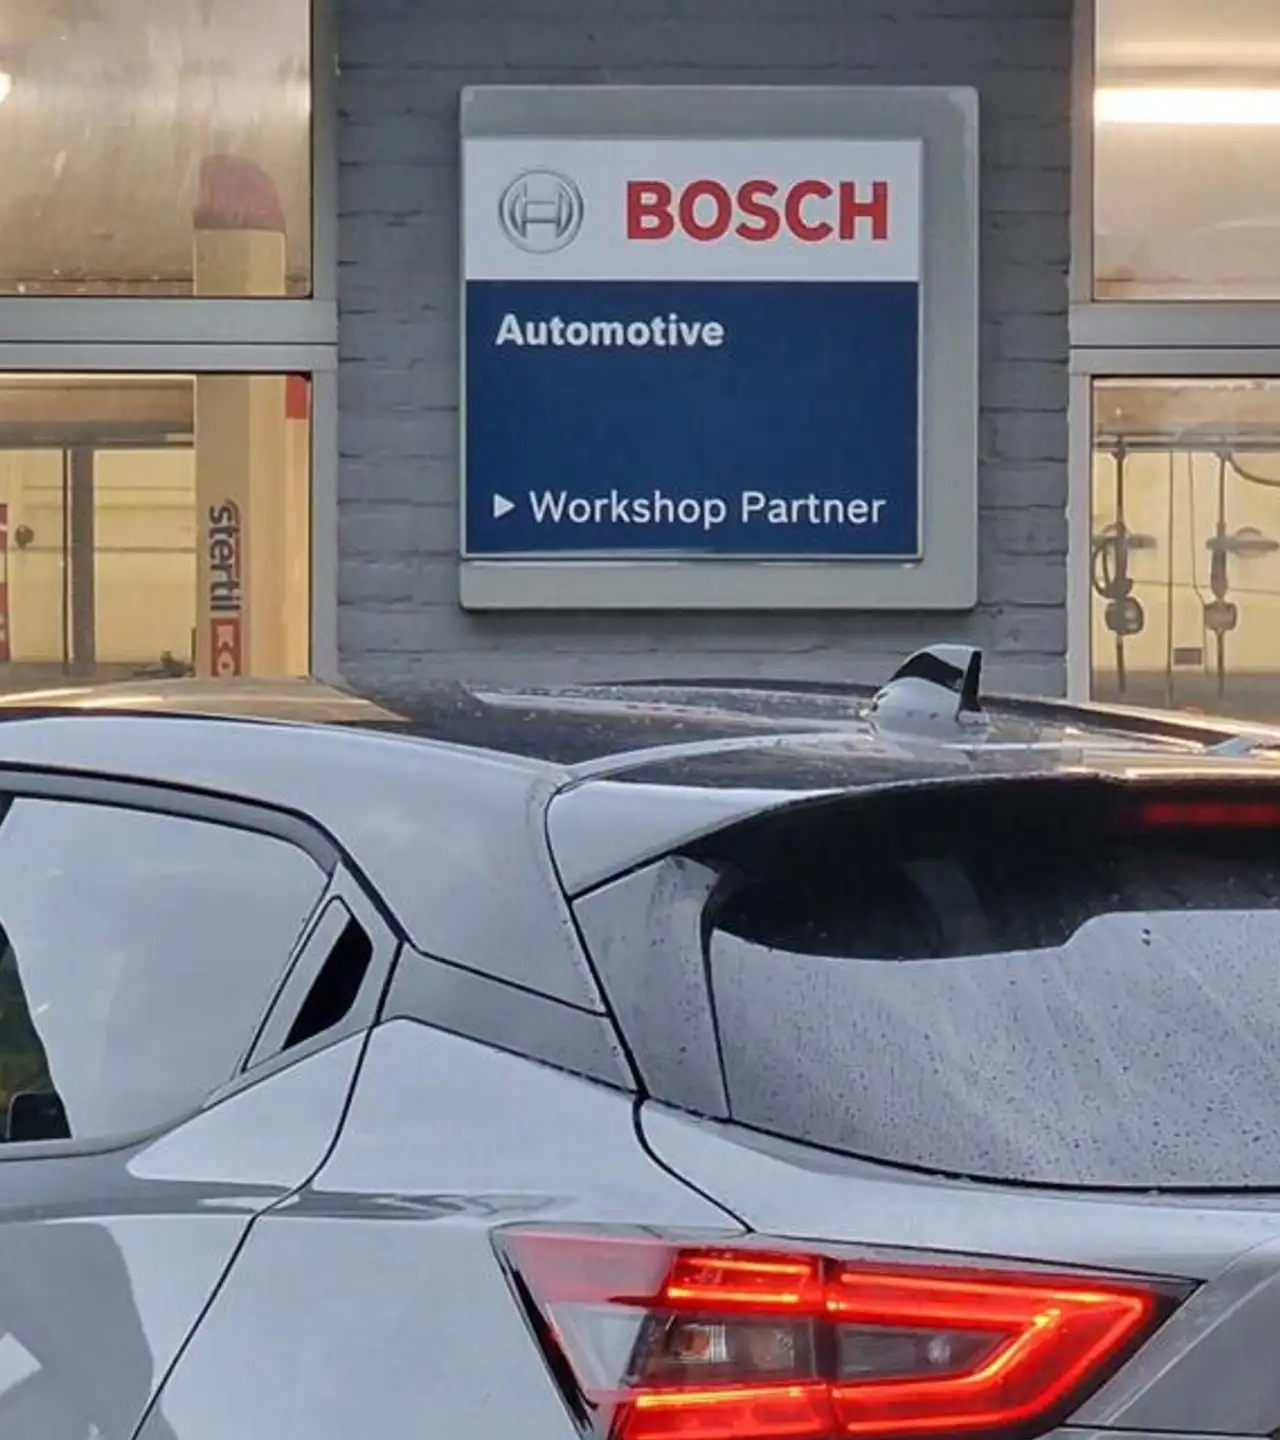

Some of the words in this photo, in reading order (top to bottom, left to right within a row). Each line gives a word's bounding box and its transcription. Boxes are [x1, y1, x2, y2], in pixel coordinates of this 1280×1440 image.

[626, 179, 889, 242] BOSCH
[495, 313, 725, 347] Automotive
[529, 490, 726, 530] Workshop
[740, 491, 886, 524] Partner
[209, 502, 241, 611] stertil
